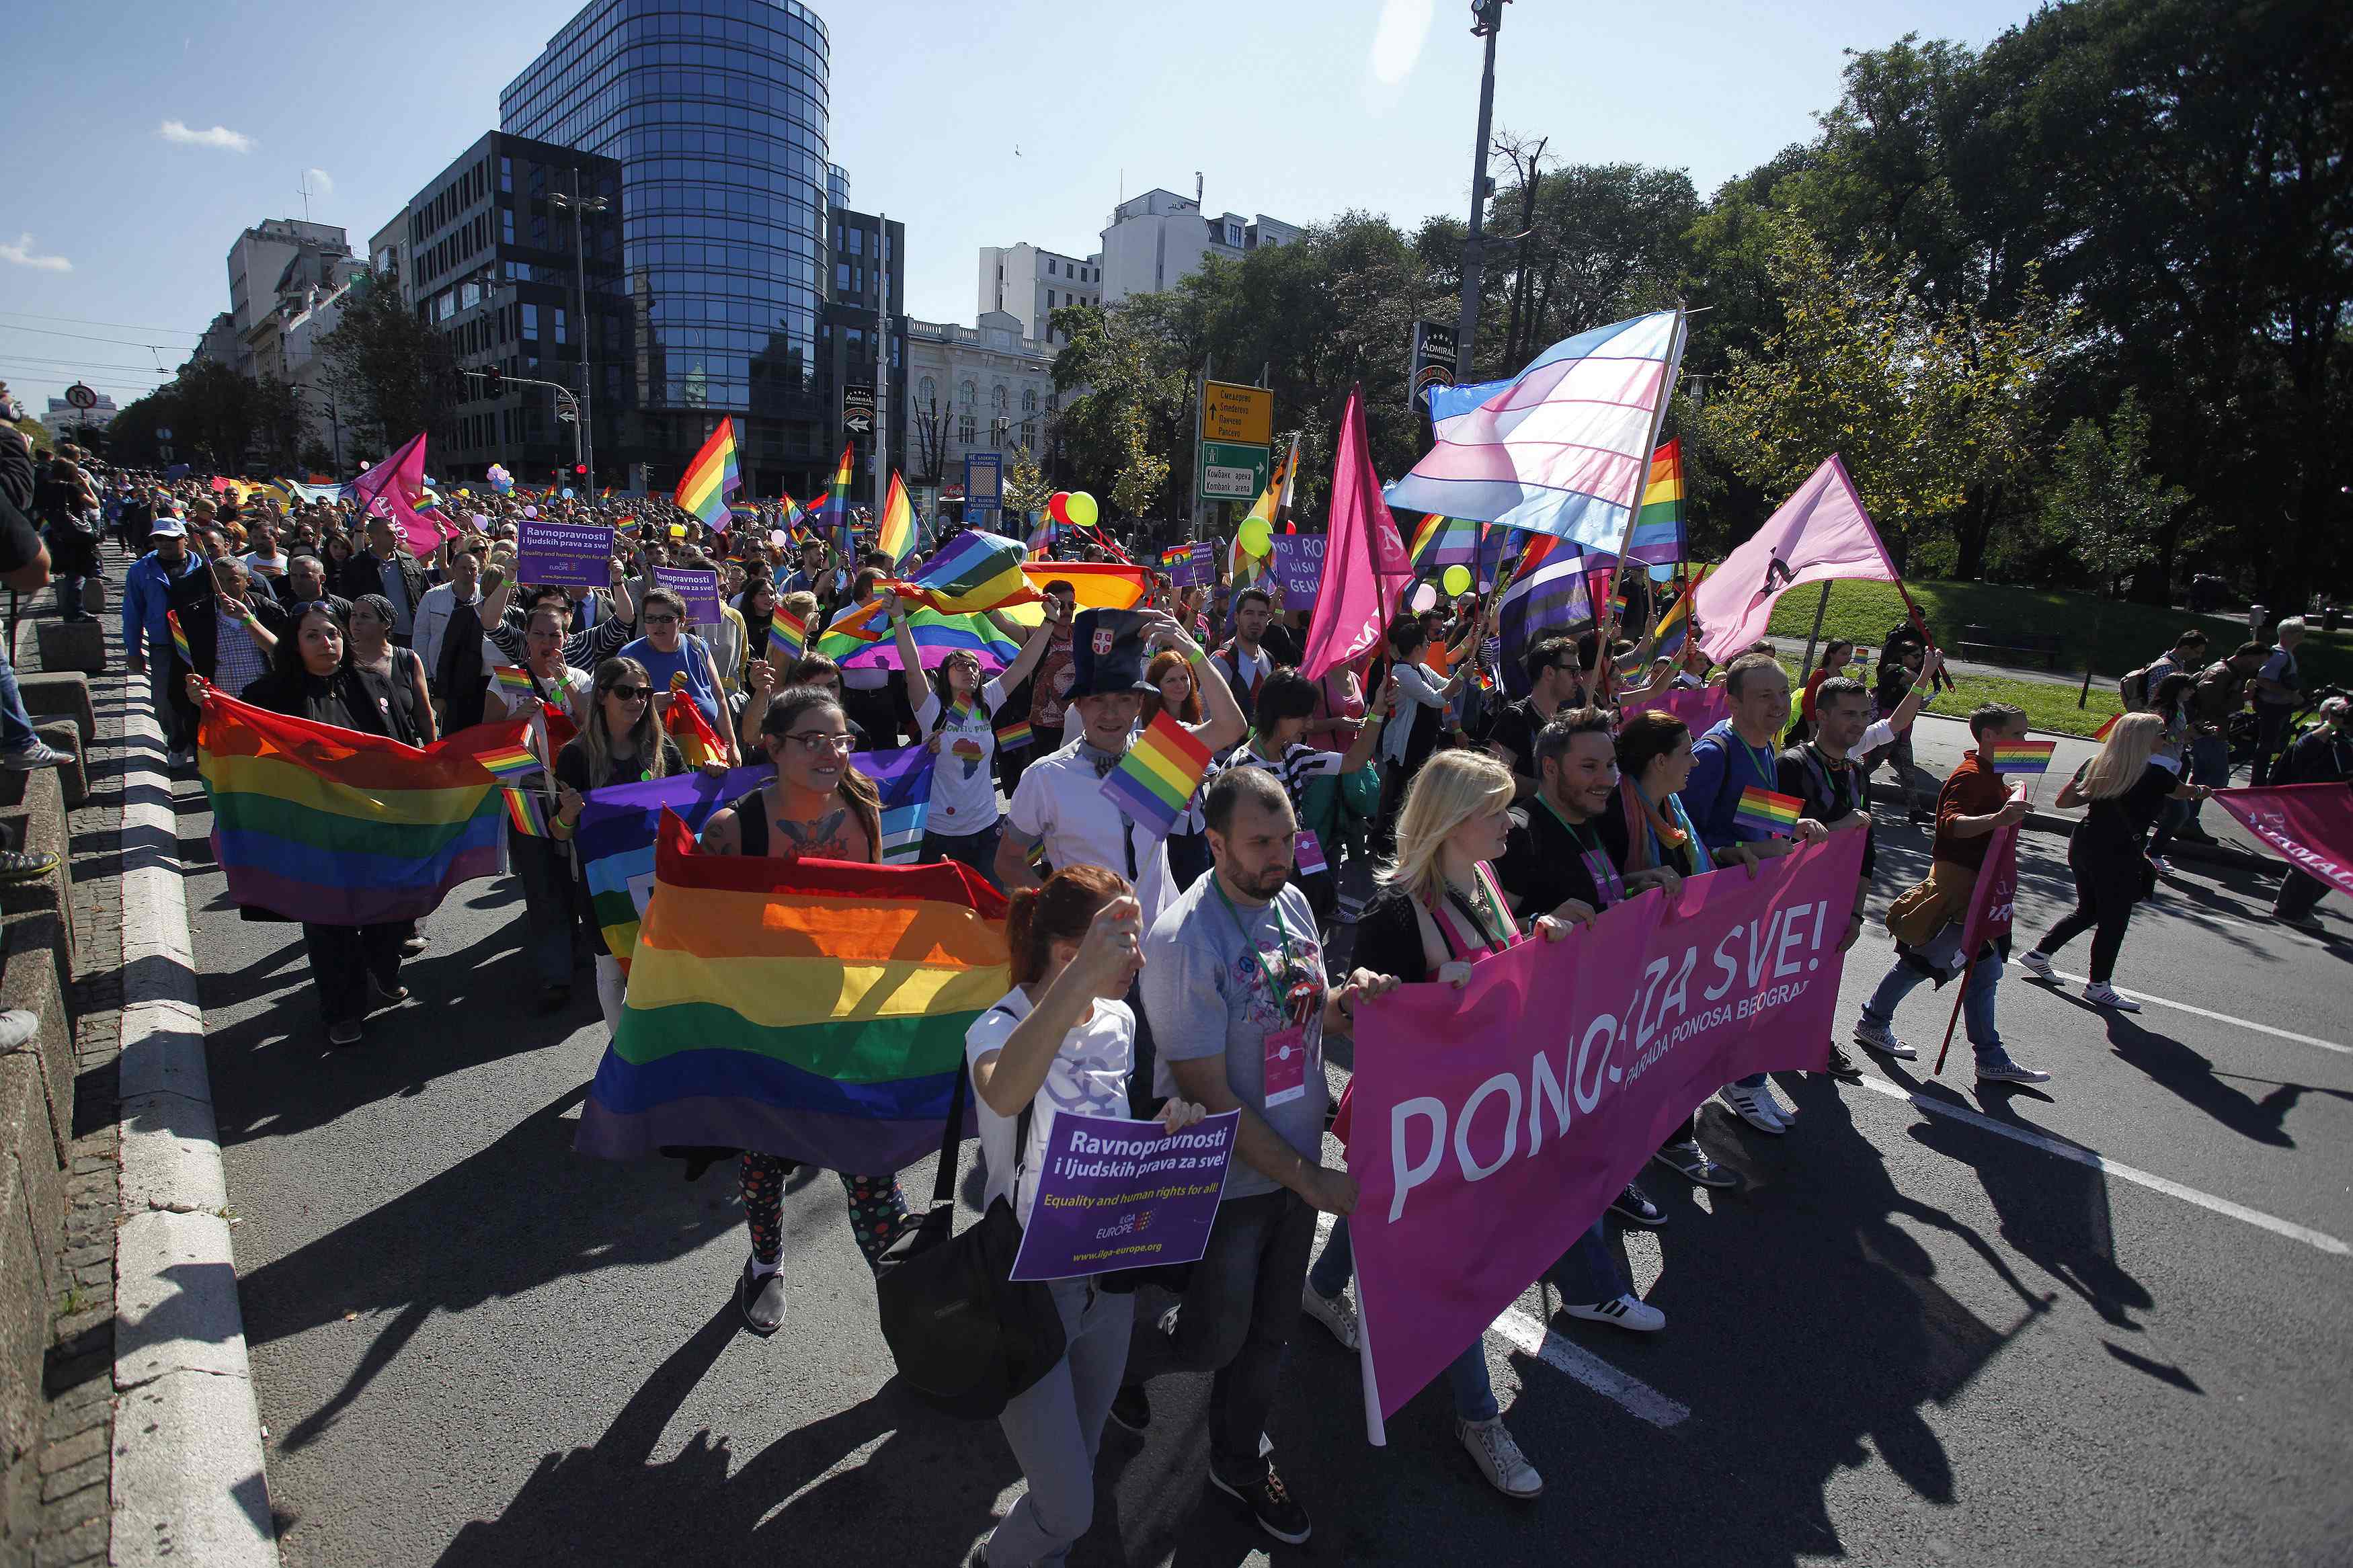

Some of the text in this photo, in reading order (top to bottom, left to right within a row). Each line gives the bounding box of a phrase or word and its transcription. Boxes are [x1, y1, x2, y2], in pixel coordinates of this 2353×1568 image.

[1421, 340, 1456, 357] ADMIRAL
[846, 395, 874, 403] ADMIRAL
[1220, 402, 1248, 415] Smederevo
[1207, 468, 1251, 481] Комбанк арена
[1206, 481, 1231, 491] Kombank
[526, 527, 606, 541] Ravnopravnosti
[527, 537, 559, 546] ljudskih
[1302, 538, 1328, 559] RO
[1636, 946, 1698, 1050] ZA
[1703, 900, 1828, 1000] SVE!
[1624, 1033, 1669, 1091] PARADA
[1671, 1004, 1732, 1048] PONOSA
[1070, 1126, 1228, 1159] Ravnopravnosti
[1053, 1150, 1227, 1180] i ljudskih prava za sve!
[1043, 1182, 1220, 1208] Equality and human rights for all!
[1119, 1213, 1135, 1225] ILGA
[1095, 1222, 1134, 1240] EUROPE
[1072, 1243, 1162, 1262] www.ilga-europe.org
